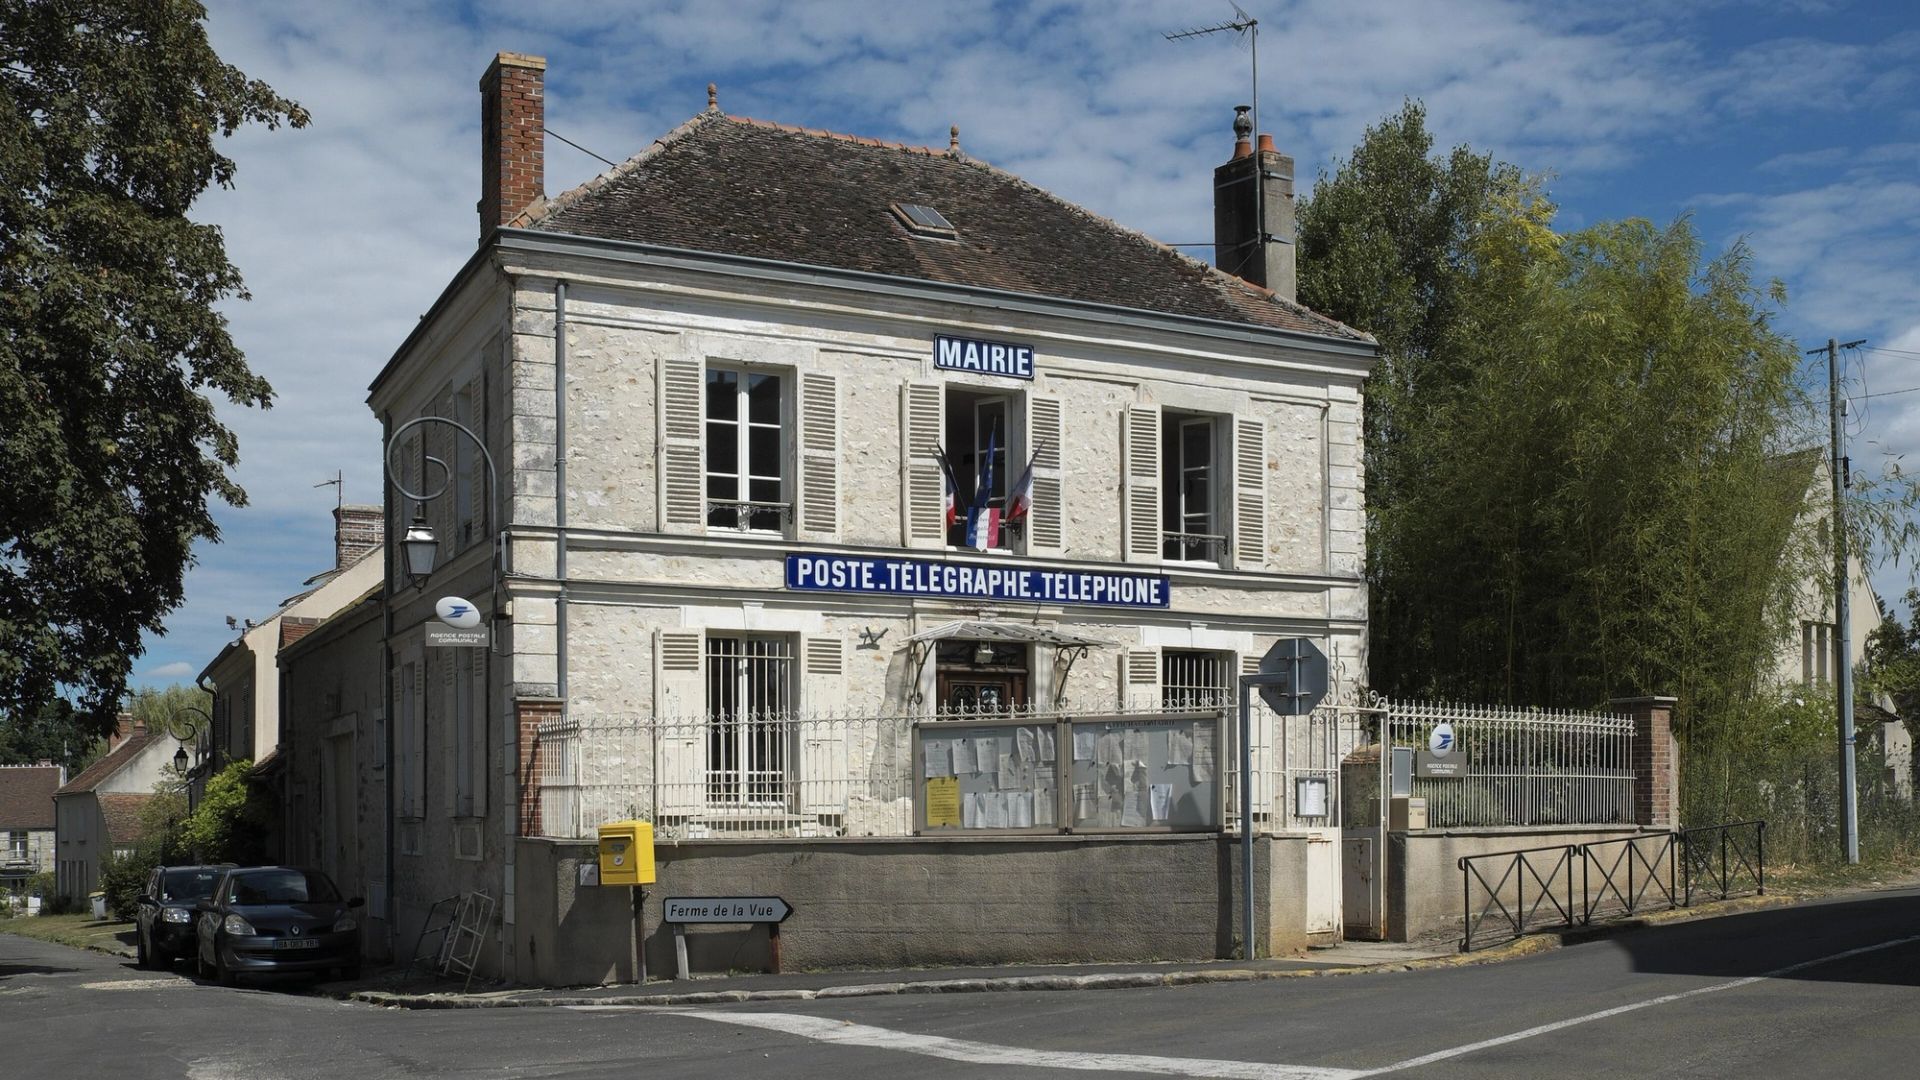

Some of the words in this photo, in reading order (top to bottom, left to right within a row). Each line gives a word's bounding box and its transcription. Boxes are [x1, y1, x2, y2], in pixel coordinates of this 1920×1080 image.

[938, 337, 1030, 377] MAIRIE
[670, 904, 708, 917] Ferme
[713, 904, 728, 917] de
[732, 904, 744, 916] la
[749, 904, 773, 916] Vue
